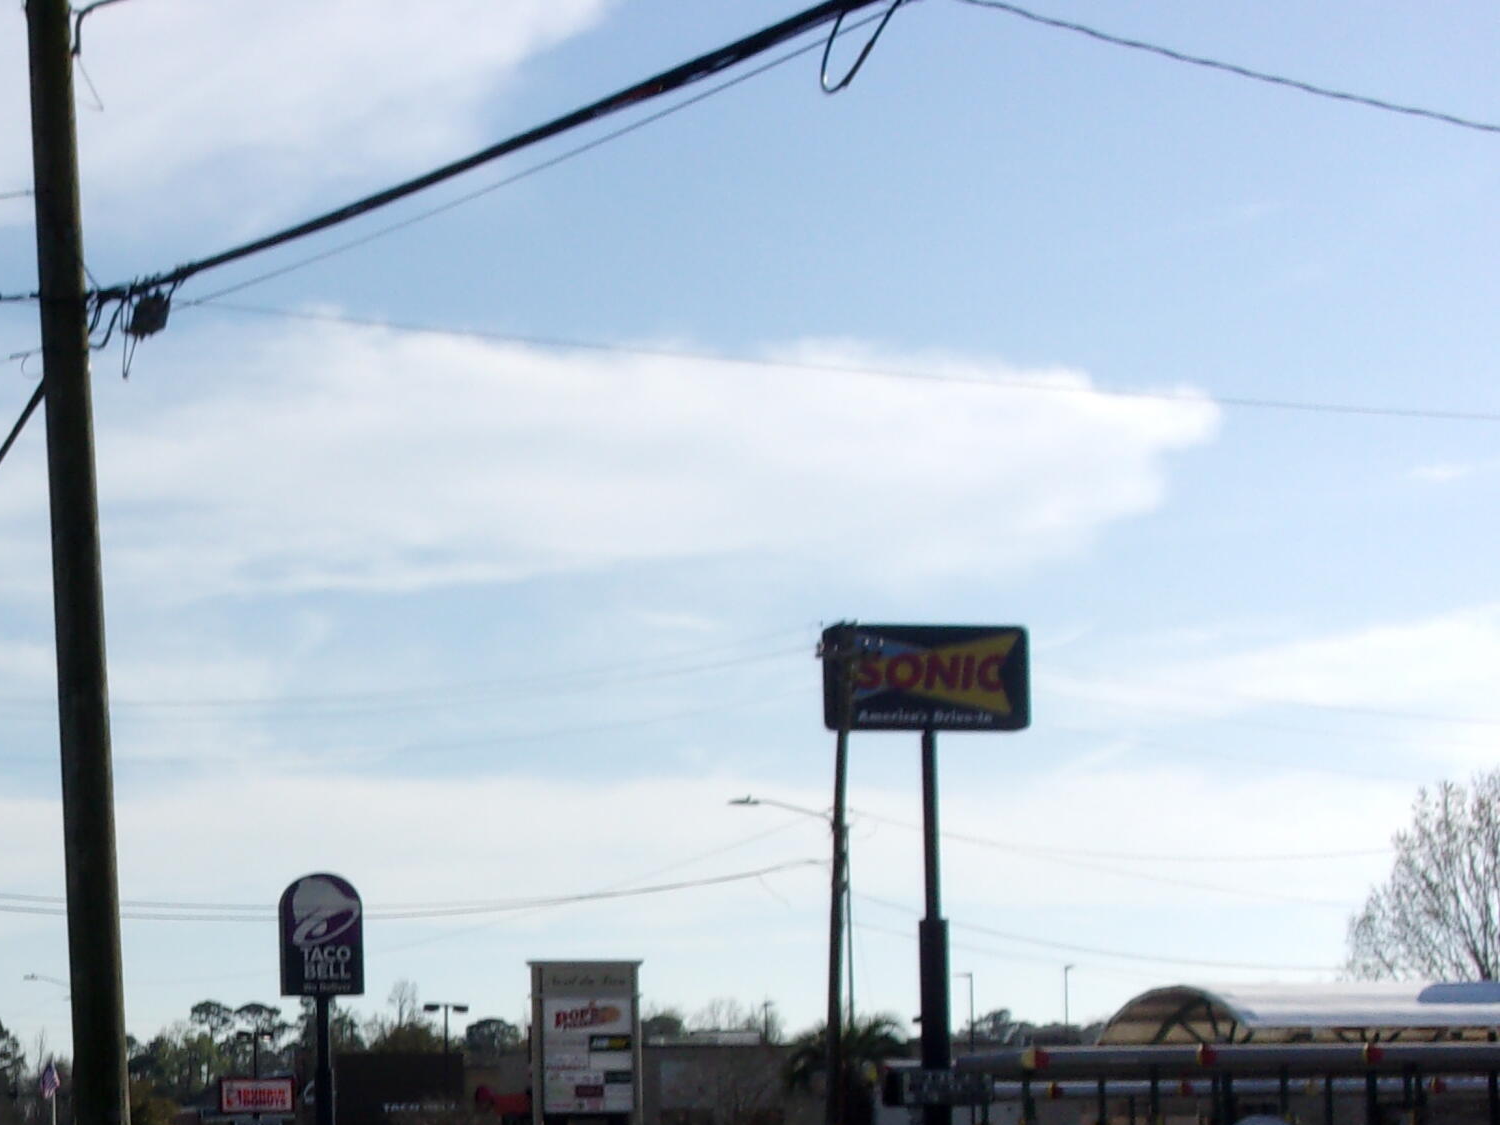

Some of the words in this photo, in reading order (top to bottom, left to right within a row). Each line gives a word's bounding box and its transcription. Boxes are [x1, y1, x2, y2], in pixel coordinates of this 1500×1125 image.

[854, 652, 1006, 691] SONIC
[300, 945, 351, 961] TACO
[304, 961, 351, 980] BELL
